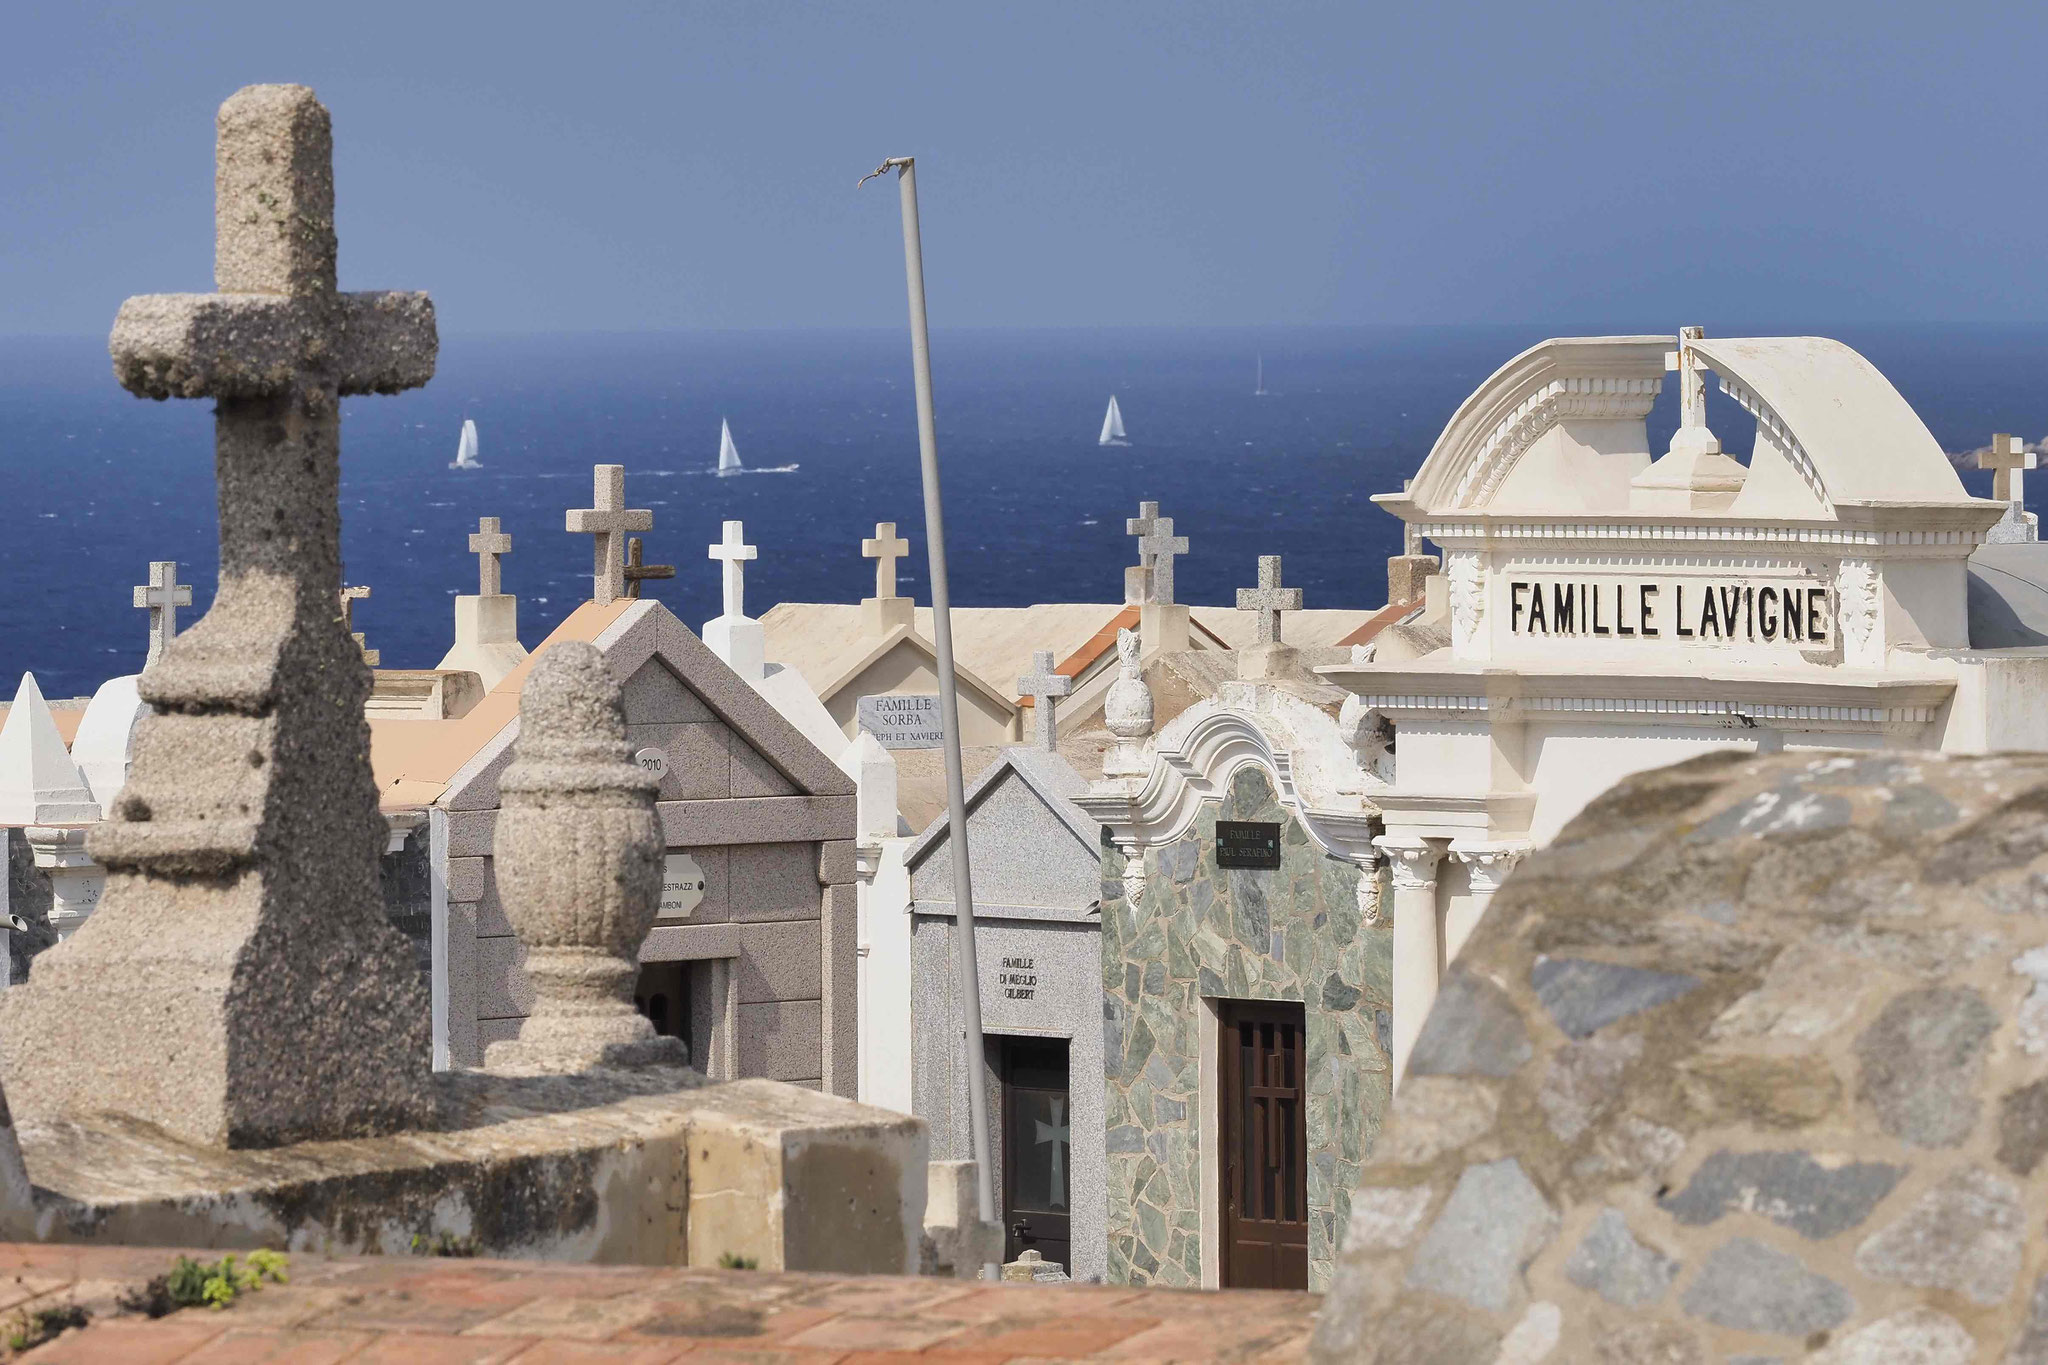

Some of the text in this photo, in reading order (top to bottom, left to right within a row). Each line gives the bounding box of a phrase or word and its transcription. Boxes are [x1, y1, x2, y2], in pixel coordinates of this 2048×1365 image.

[1510, 582, 1826, 640] FAMILLE LAVIGNE
[875, 698, 932, 712] FAMILLE
[882, 713, 922, 726] SORBA
[896, 732, 906, 741] ET
[642, 758, 662, 771] 2010
[1230, 829, 1261, 840] FAMILLE
[661, 882, 693, 892] ESTRAZZI
[1002, 957, 1034, 969] FAMILLE
[999, 973, 1037, 986] DI MEGLIO
[1004, 988, 1035, 1000] GILBERT
